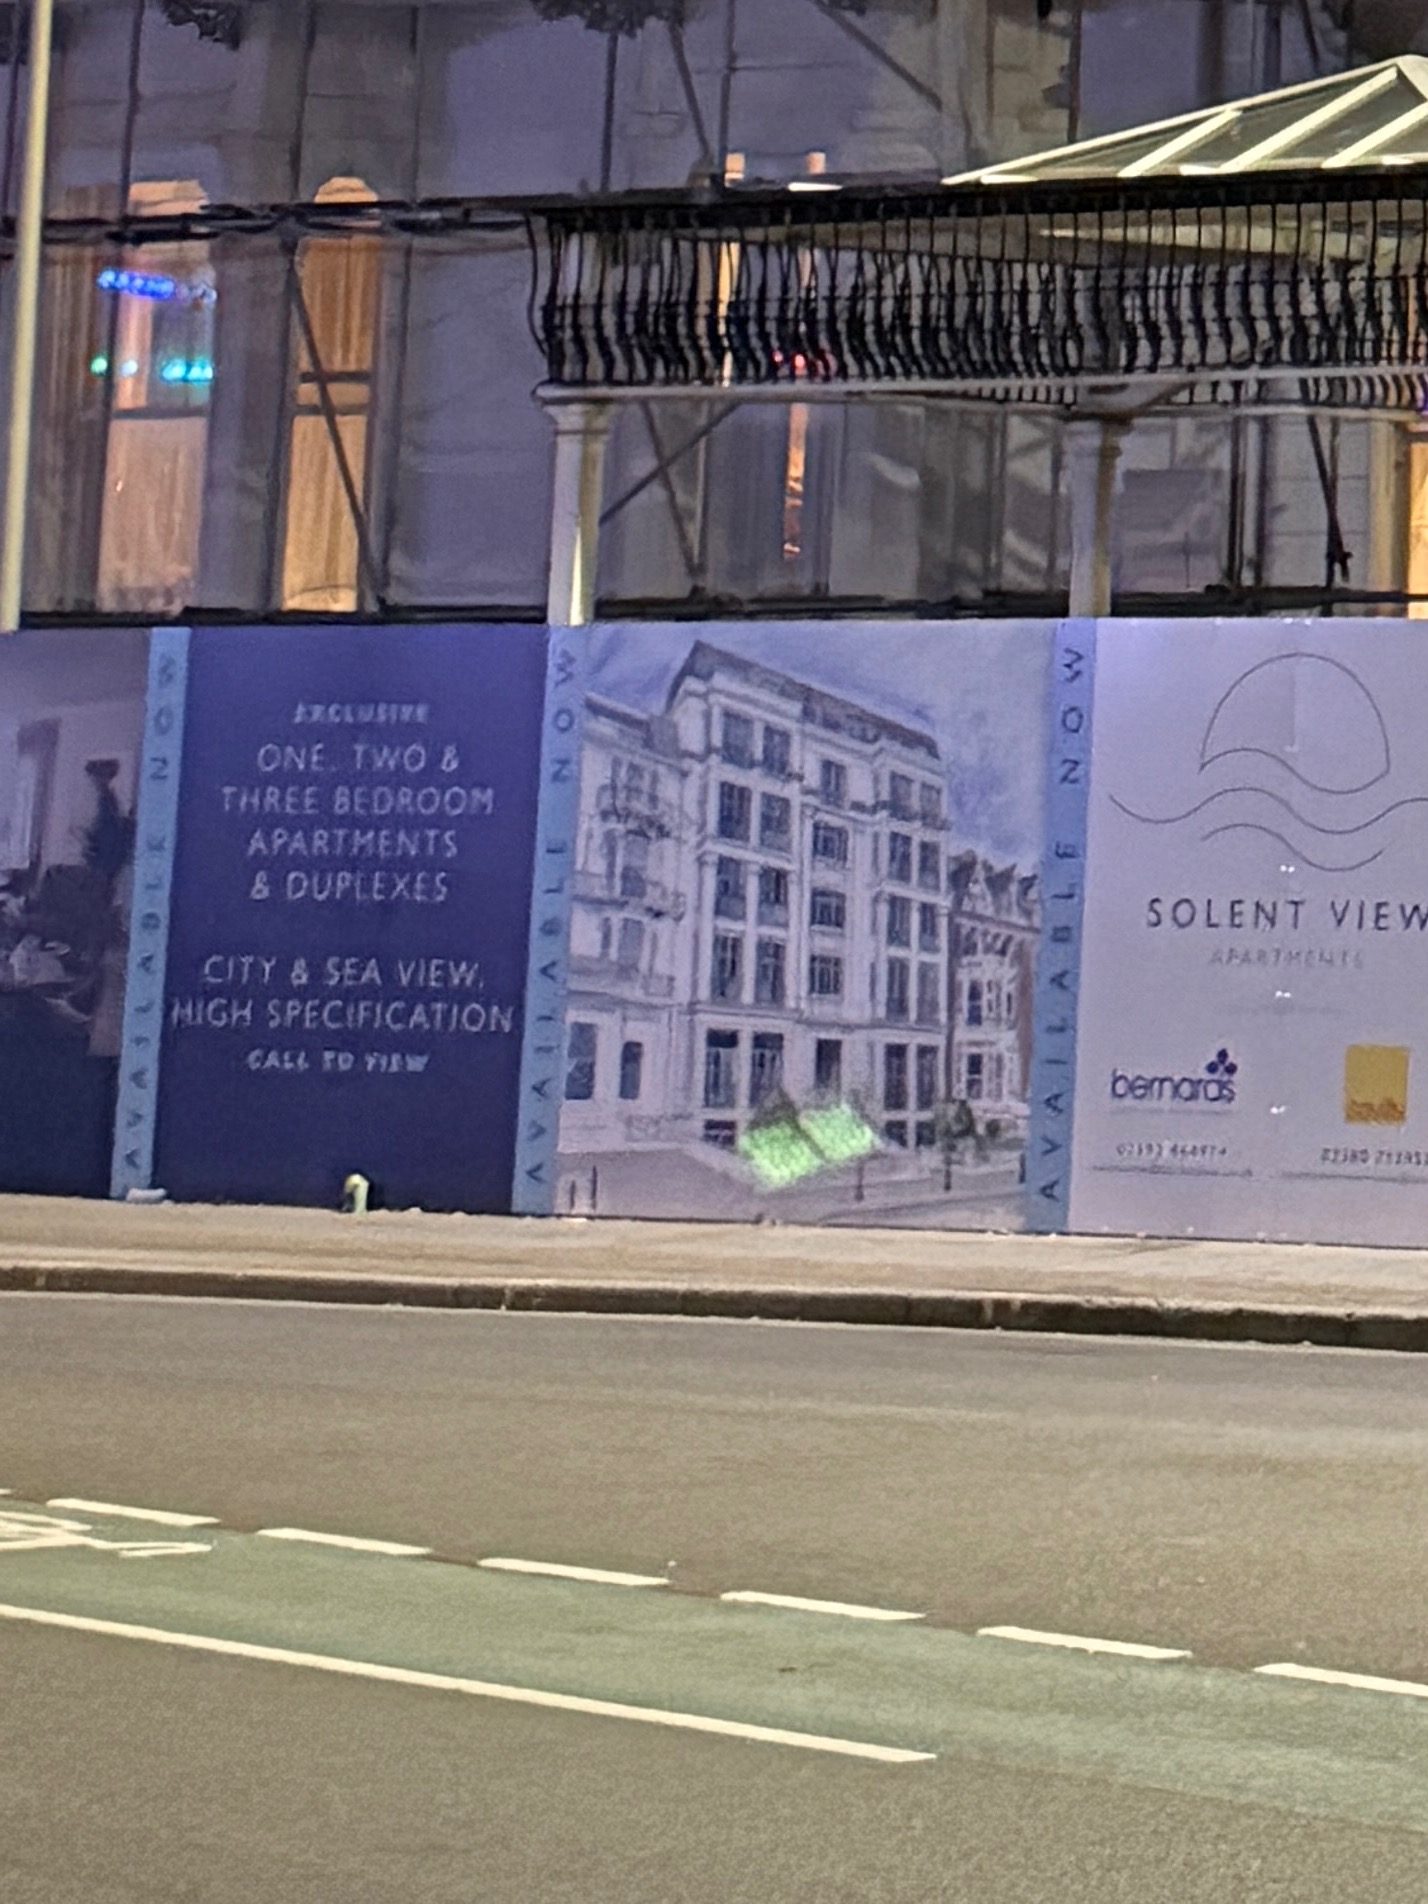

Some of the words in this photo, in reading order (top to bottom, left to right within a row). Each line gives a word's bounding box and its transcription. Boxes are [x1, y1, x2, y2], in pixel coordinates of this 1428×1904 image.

[1058, 646, 1086, 784] NOW
[354, 743, 426, 773] TWO
[440, 743, 459, 773] &
[222, 785, 319, 815] THREE
[334, 785, 495, 817] BEDROOM
[248, 827, 458, 859] APARTMENTS
[250, 870, 270, 900] &
[286, 870, 448, 902] DUPLEXES
[527, 838, 568, 1184] AVAILABLE
[550, 648, 578, 782] NOW
[1145, 897, 1306, 932] SOLENT
[204, 955, 277, 985] CITY
[291, 957, 309, 987] &
[325, 956, 382, 986] SEA
[1208, 947, 1364, 970] APARTMENTS
[171, 997, 253, 1028] HIGH
[267, 998, 515, 1033] SPECIFICATION
[1039, 840, 1079, 1202] AVAILABLE
[247, 1048, 309, 1071] CALL
[323, 1050, 355, 1072] TO
[365, 1051, 430, 1073] VIEW
